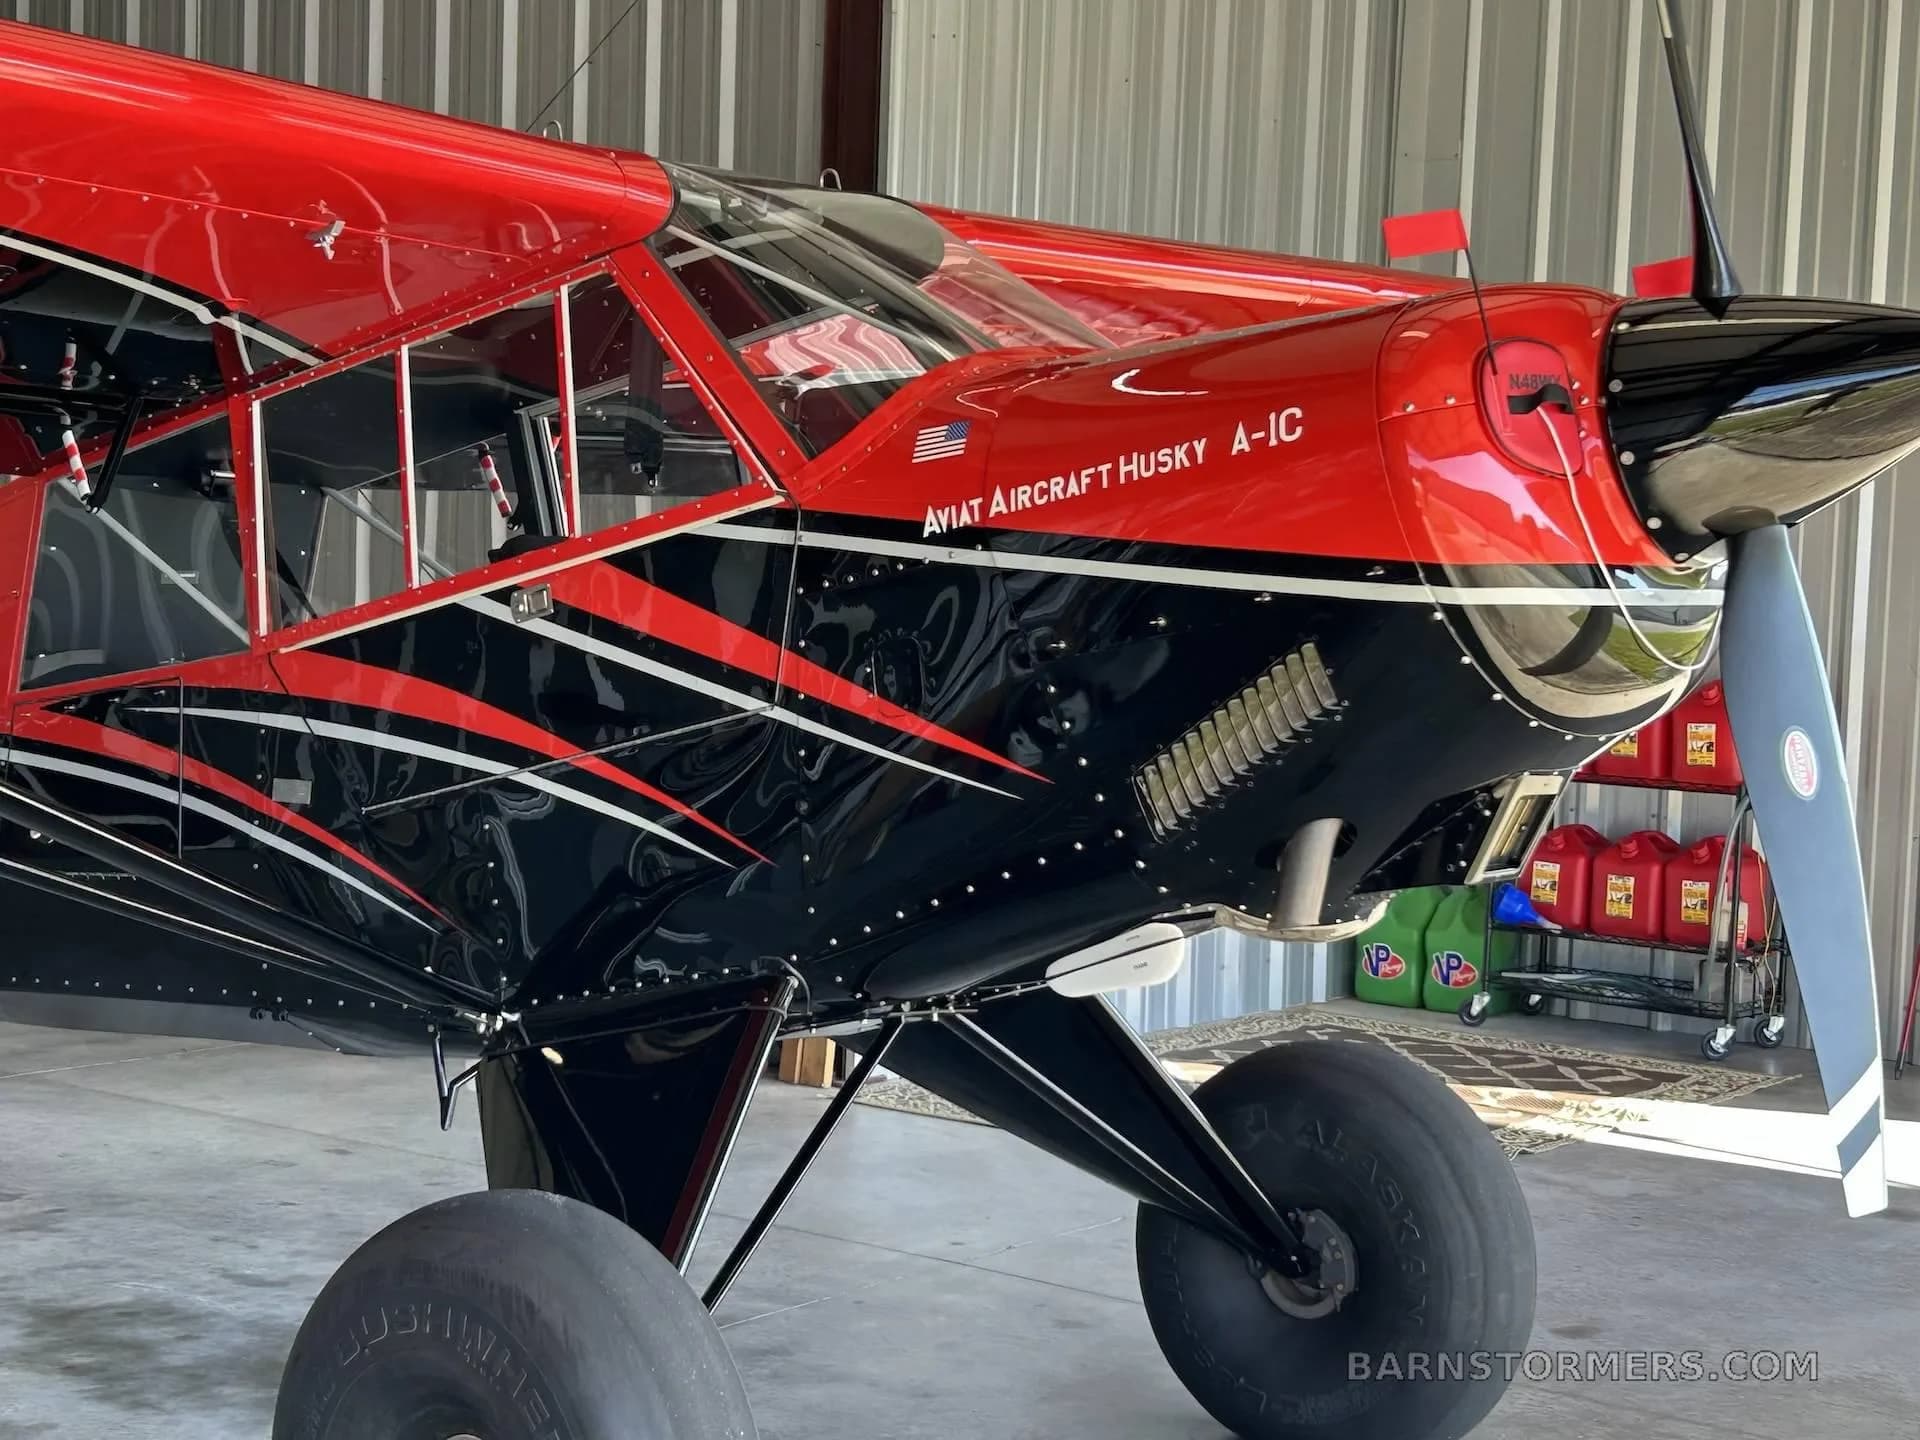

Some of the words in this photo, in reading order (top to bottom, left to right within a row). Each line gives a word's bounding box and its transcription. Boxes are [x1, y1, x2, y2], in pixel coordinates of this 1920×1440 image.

[923, 497, 983, 538] AVIAT
[988, 462, 1113, 518] AIRCRAFT
[1118, 437, 1208, 485] HUSKY
[1230, 406, 1303, 456] A-1C
[1363, 943, 1392, 977] VP
[1433, 951, 1464, 987] VP
